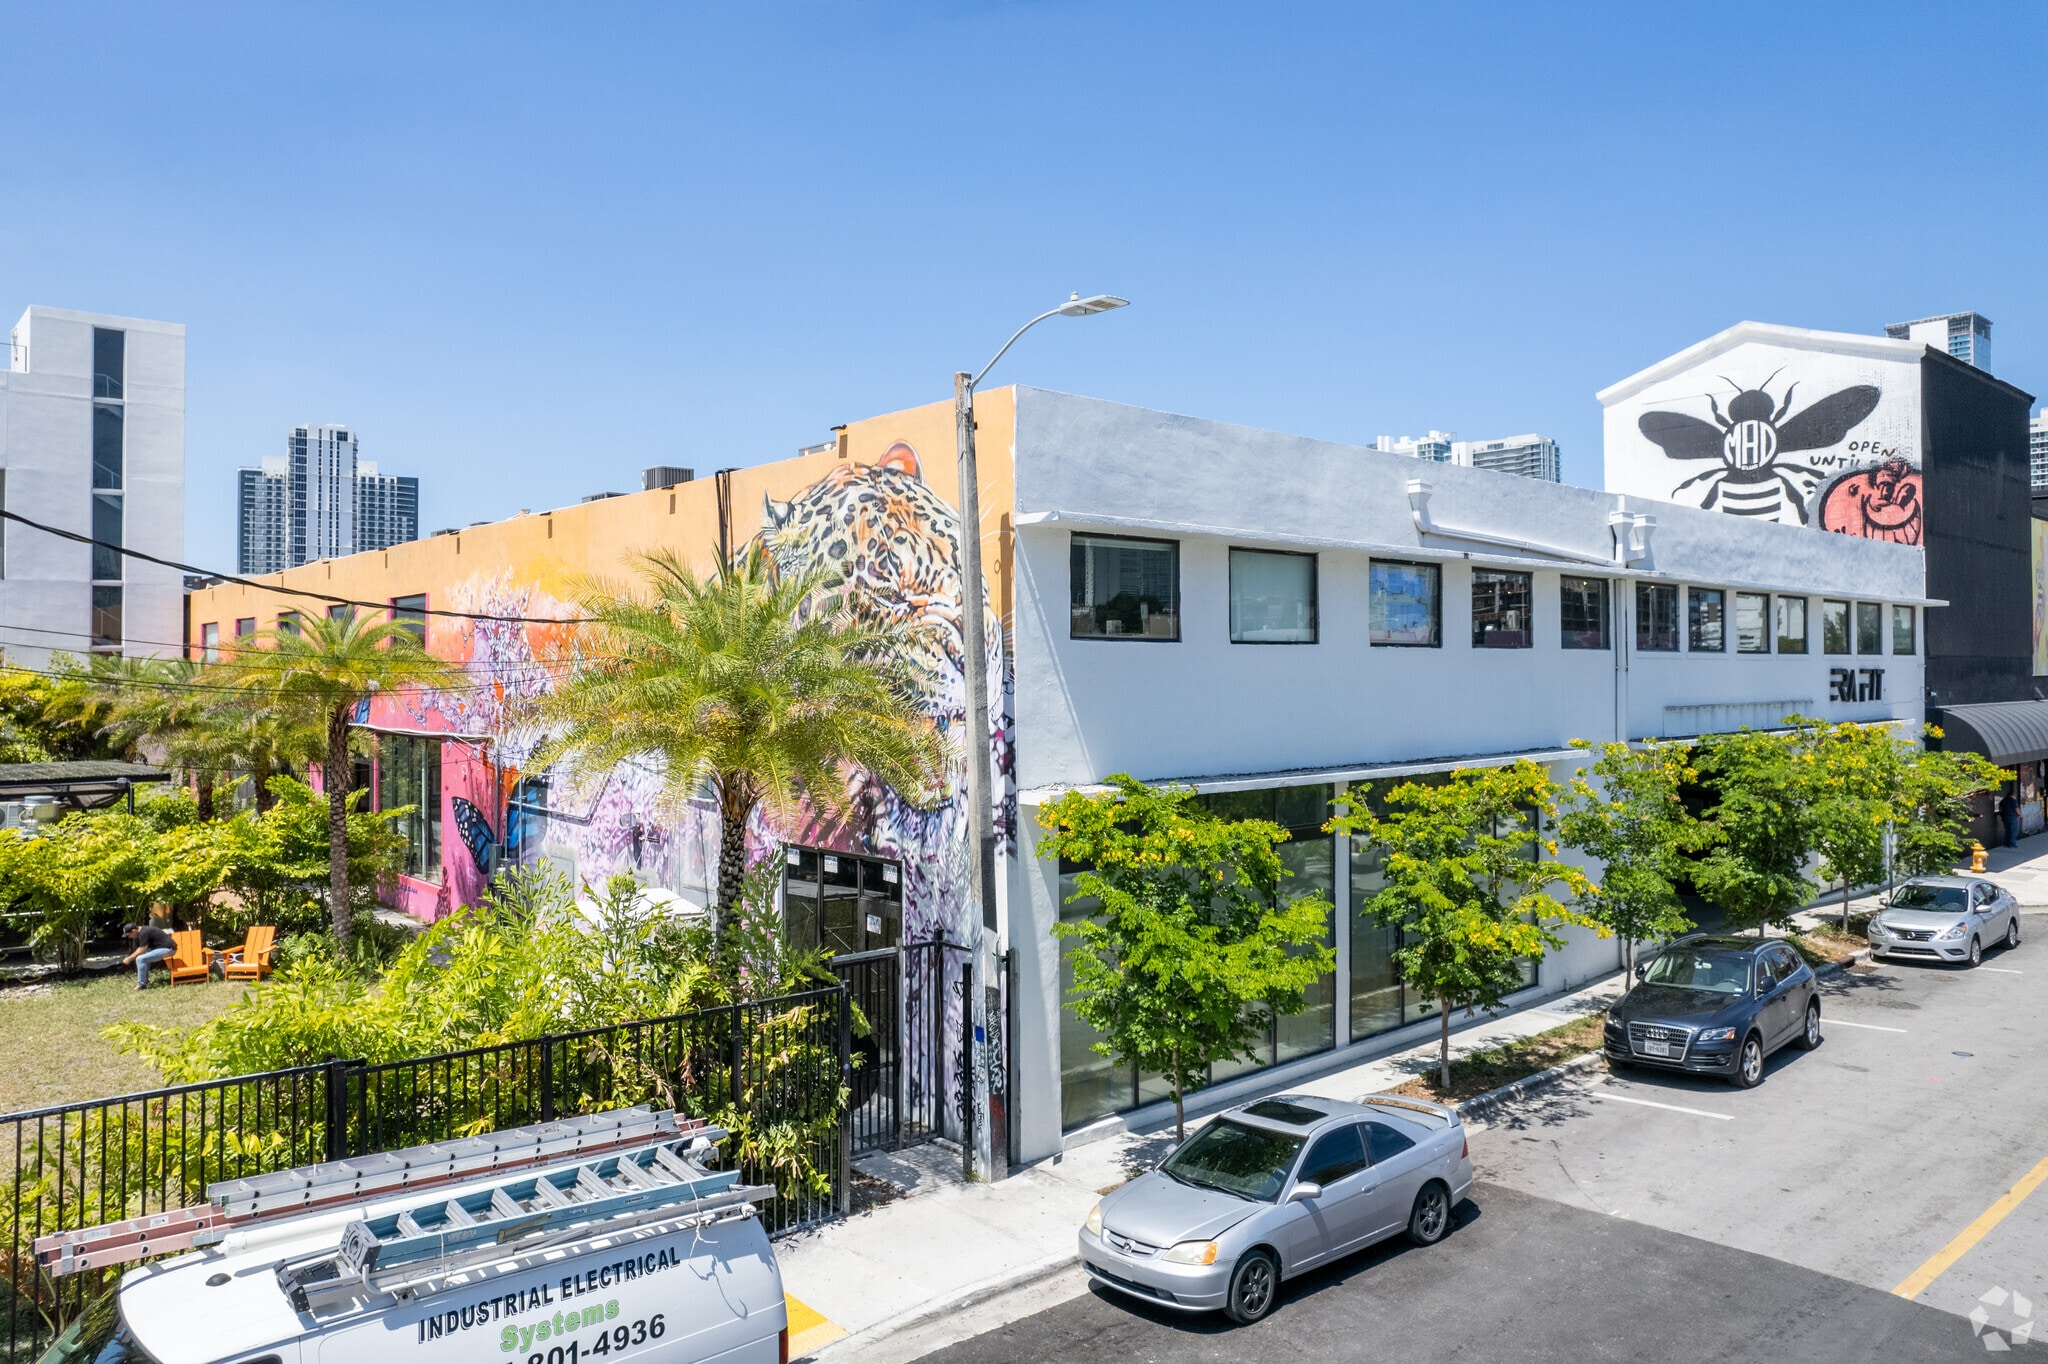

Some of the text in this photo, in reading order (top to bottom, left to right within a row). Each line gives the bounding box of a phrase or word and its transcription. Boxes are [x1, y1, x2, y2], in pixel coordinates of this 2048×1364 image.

[1723, 419, 1777, 469] MAD
[1848, 441, 1896, 457] OPEN
[1829, 668, 1885, 702] ERA FIT
[418, 1246, 681, 1344] INDUSTRIAL ELECTRICAL
[500, 1299, 620, 1353] Systems
